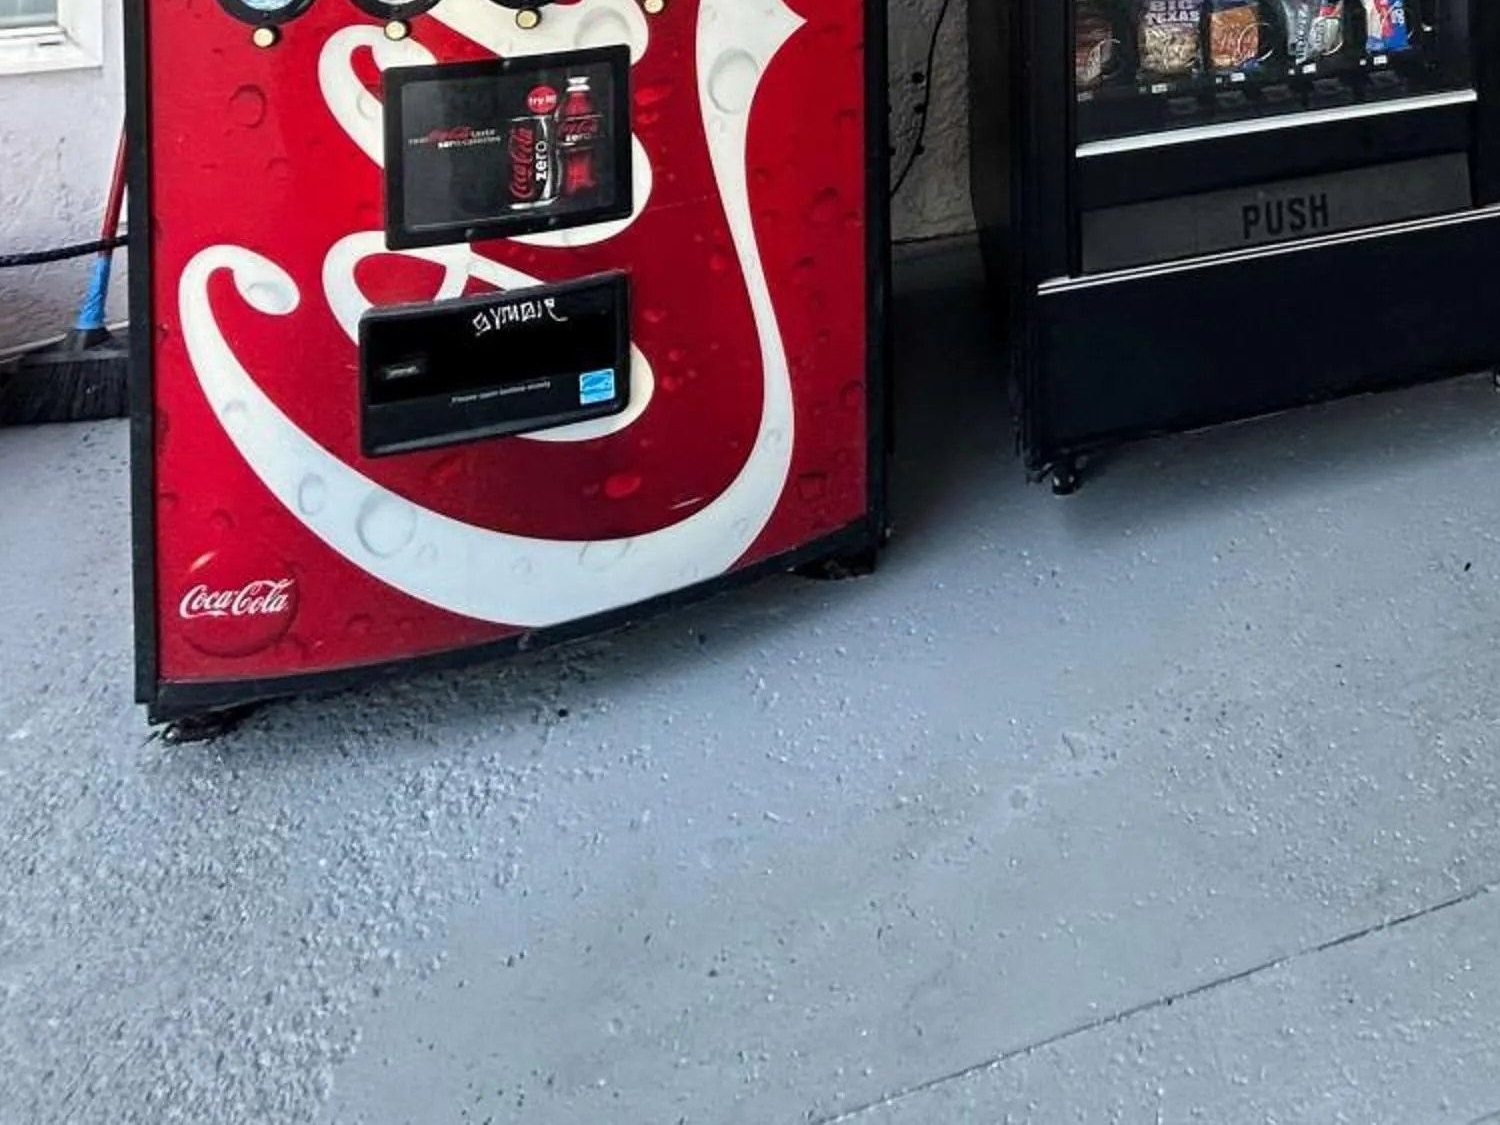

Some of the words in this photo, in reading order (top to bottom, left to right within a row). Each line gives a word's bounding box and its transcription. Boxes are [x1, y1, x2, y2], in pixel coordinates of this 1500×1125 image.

[1145, 10, 1200, 23] TEXAS
[535, 140, 548, 181] zero
[1242, 193, 1330, 240] PUSH
[179, 578, 295, 619] Coca-Cola
